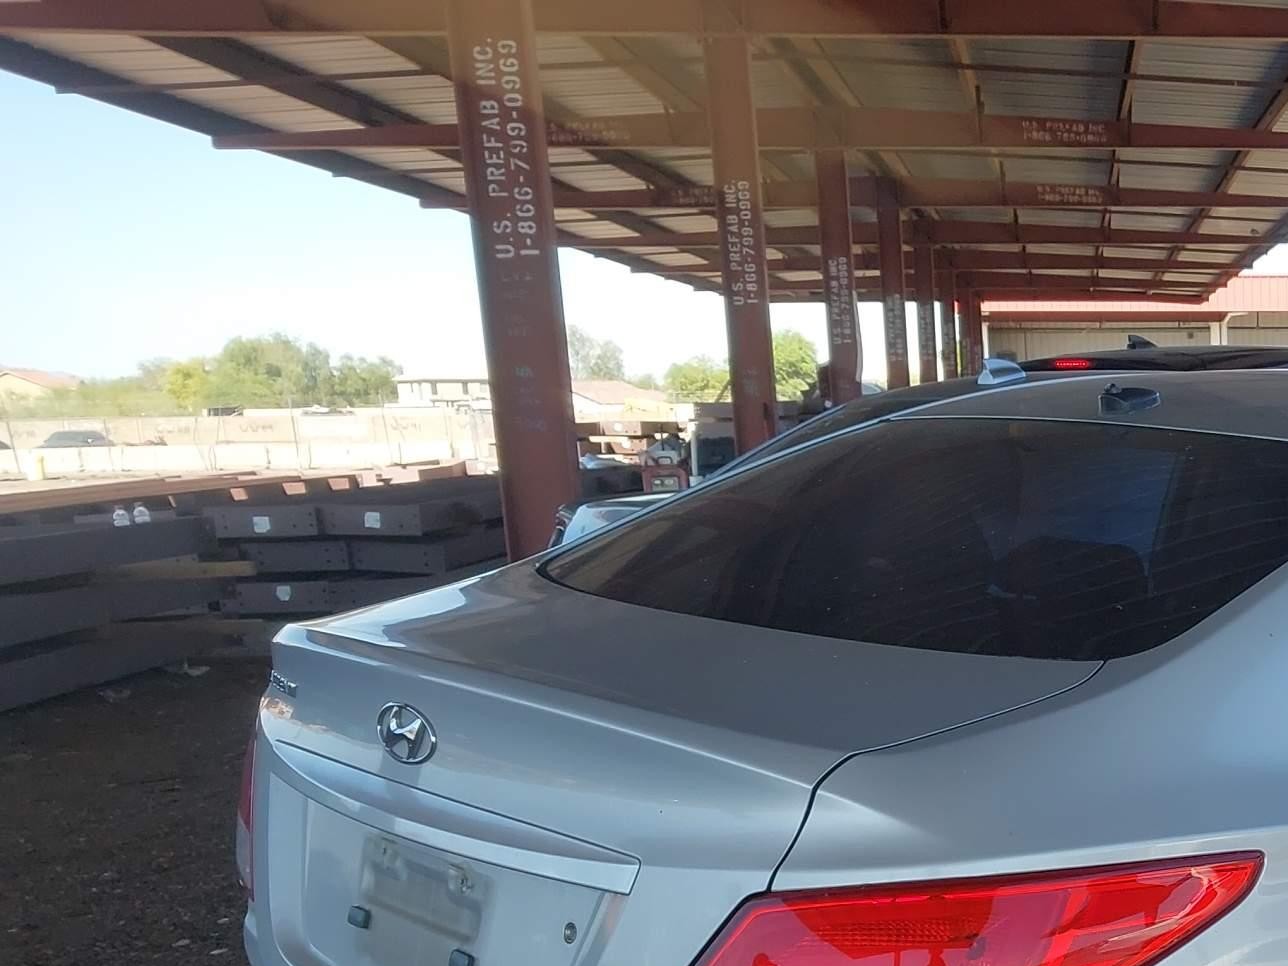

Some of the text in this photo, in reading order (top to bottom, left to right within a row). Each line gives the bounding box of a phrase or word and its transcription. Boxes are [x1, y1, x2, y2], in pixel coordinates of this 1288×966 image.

[473, 38, 514, 258] U.S. PREFAB INC.
[497, 39, 540, 256] 1-866-799-0969
[726, 215, 742, 271] PREFAB
[738, 180, 759, 304] 1-866-799-0969
